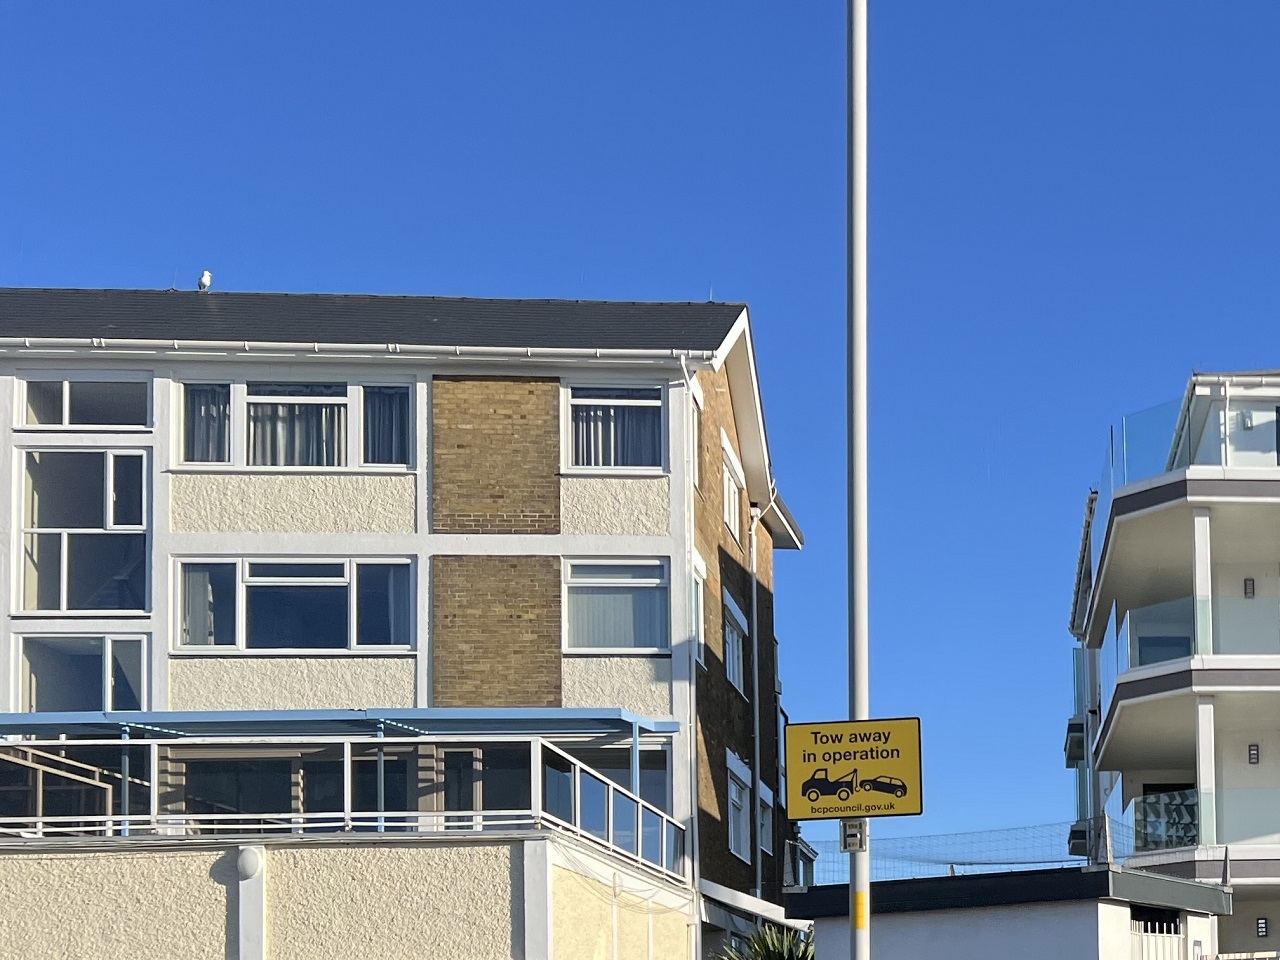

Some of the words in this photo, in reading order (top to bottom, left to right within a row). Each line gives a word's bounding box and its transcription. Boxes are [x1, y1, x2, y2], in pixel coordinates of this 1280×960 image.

[810, 731, 843, 745] Tow
[848, 730, 891, 744] away
[802, 749, 817, 763] in
[822, 746, 900, 764] operation
[811, 802, 895, 815] bcpcouncil.gov.uk
